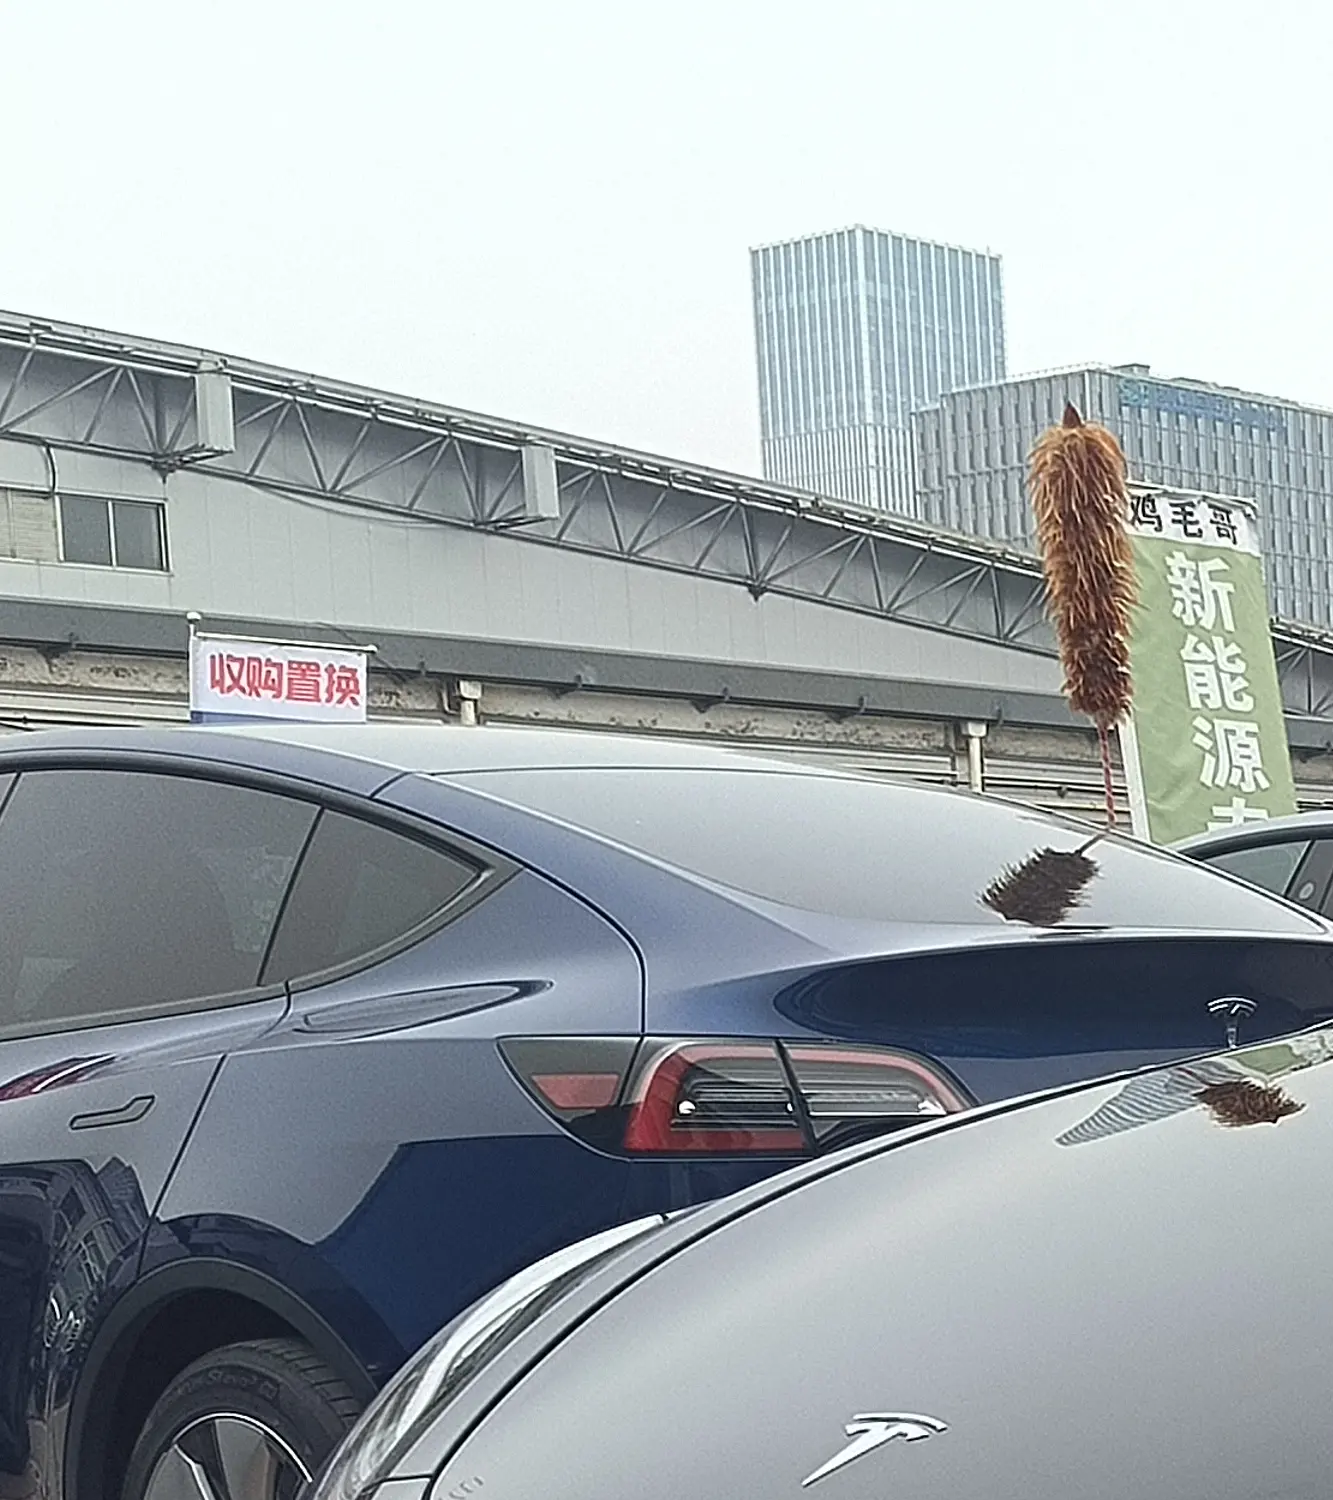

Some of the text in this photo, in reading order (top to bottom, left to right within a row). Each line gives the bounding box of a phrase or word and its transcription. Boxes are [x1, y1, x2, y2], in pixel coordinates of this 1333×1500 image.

[1131, 494, 1238, 545] 鸡毛哥
[210, 653, 360, 706] 收购置换
